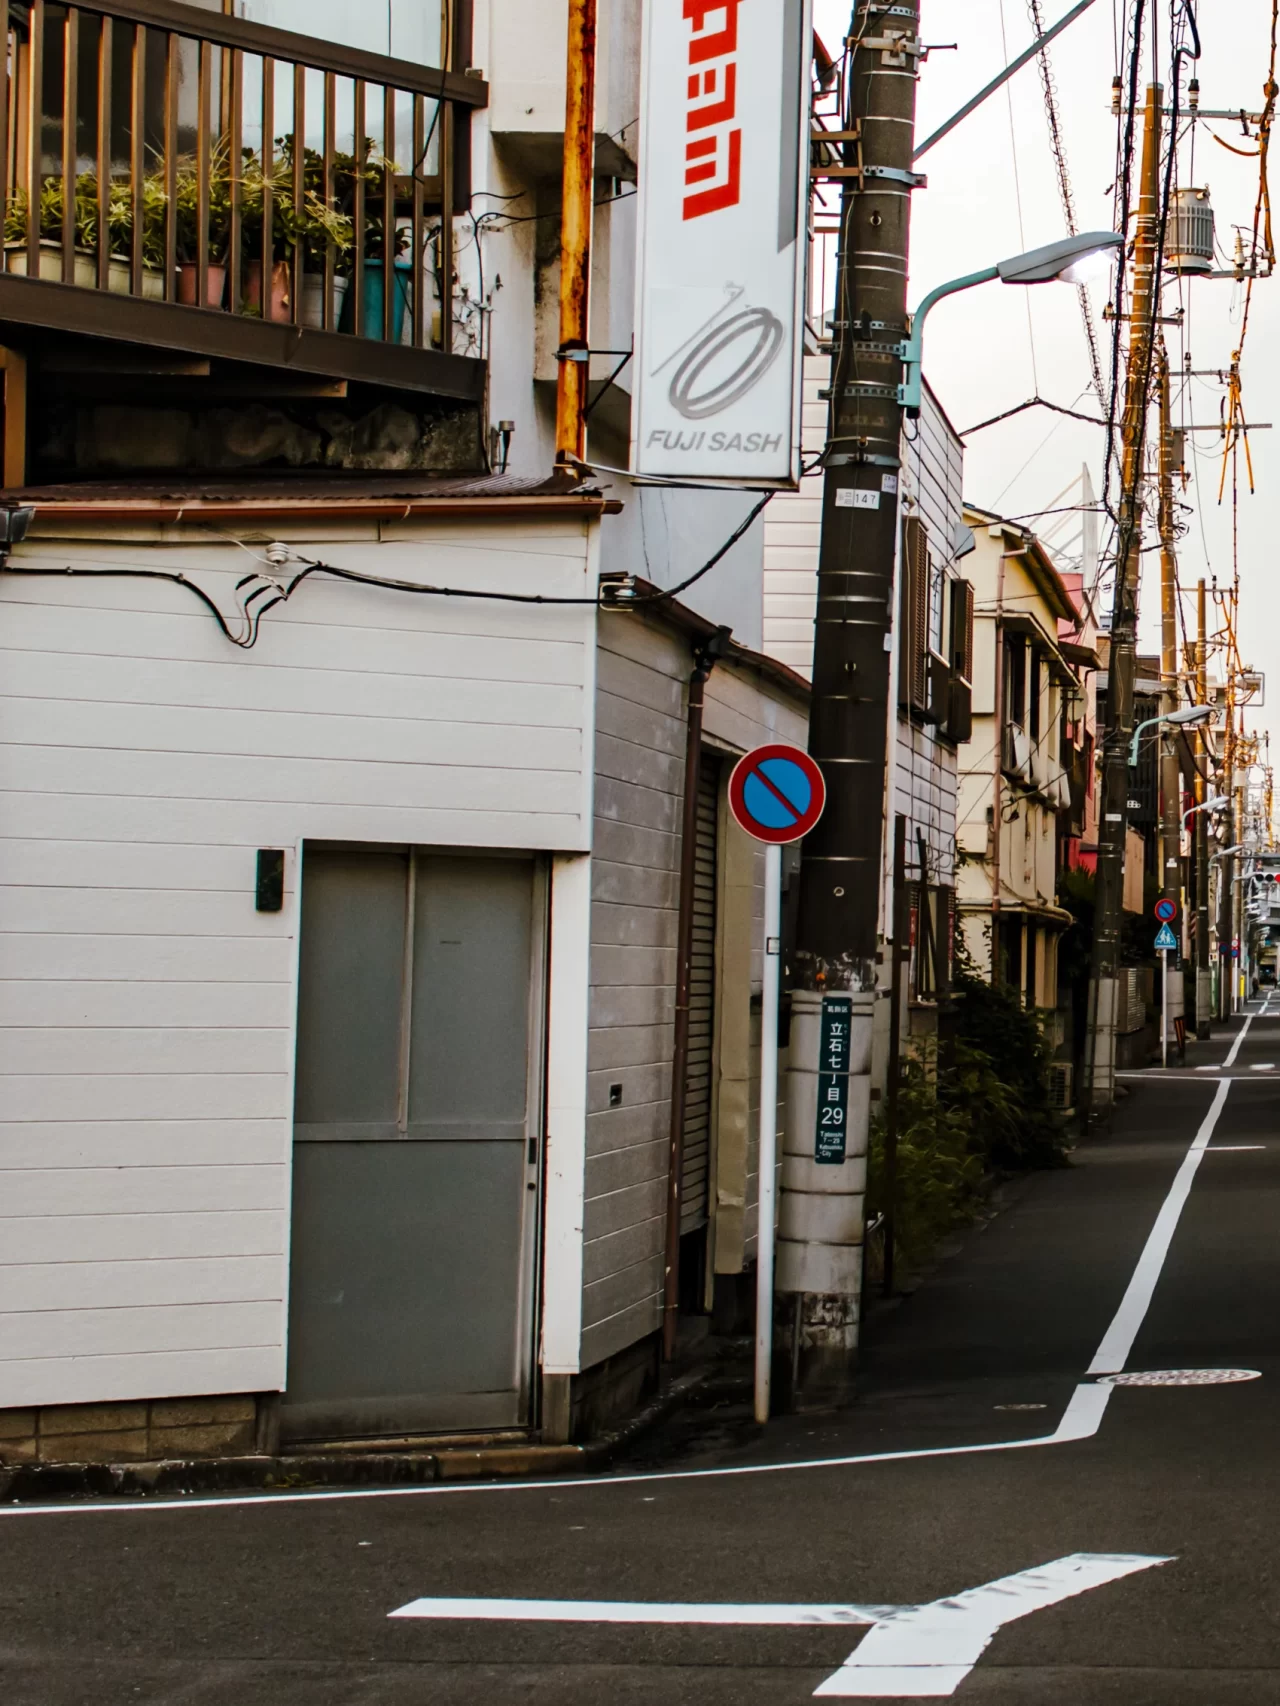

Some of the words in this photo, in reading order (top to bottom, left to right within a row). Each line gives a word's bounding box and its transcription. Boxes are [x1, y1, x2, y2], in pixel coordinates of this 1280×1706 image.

[645, 429, 706, 451] FUJI
[708, 431, 783, 453] SASH
[855, 493, 876, 505] 147
[821, 1107, 844, 1125] 29
